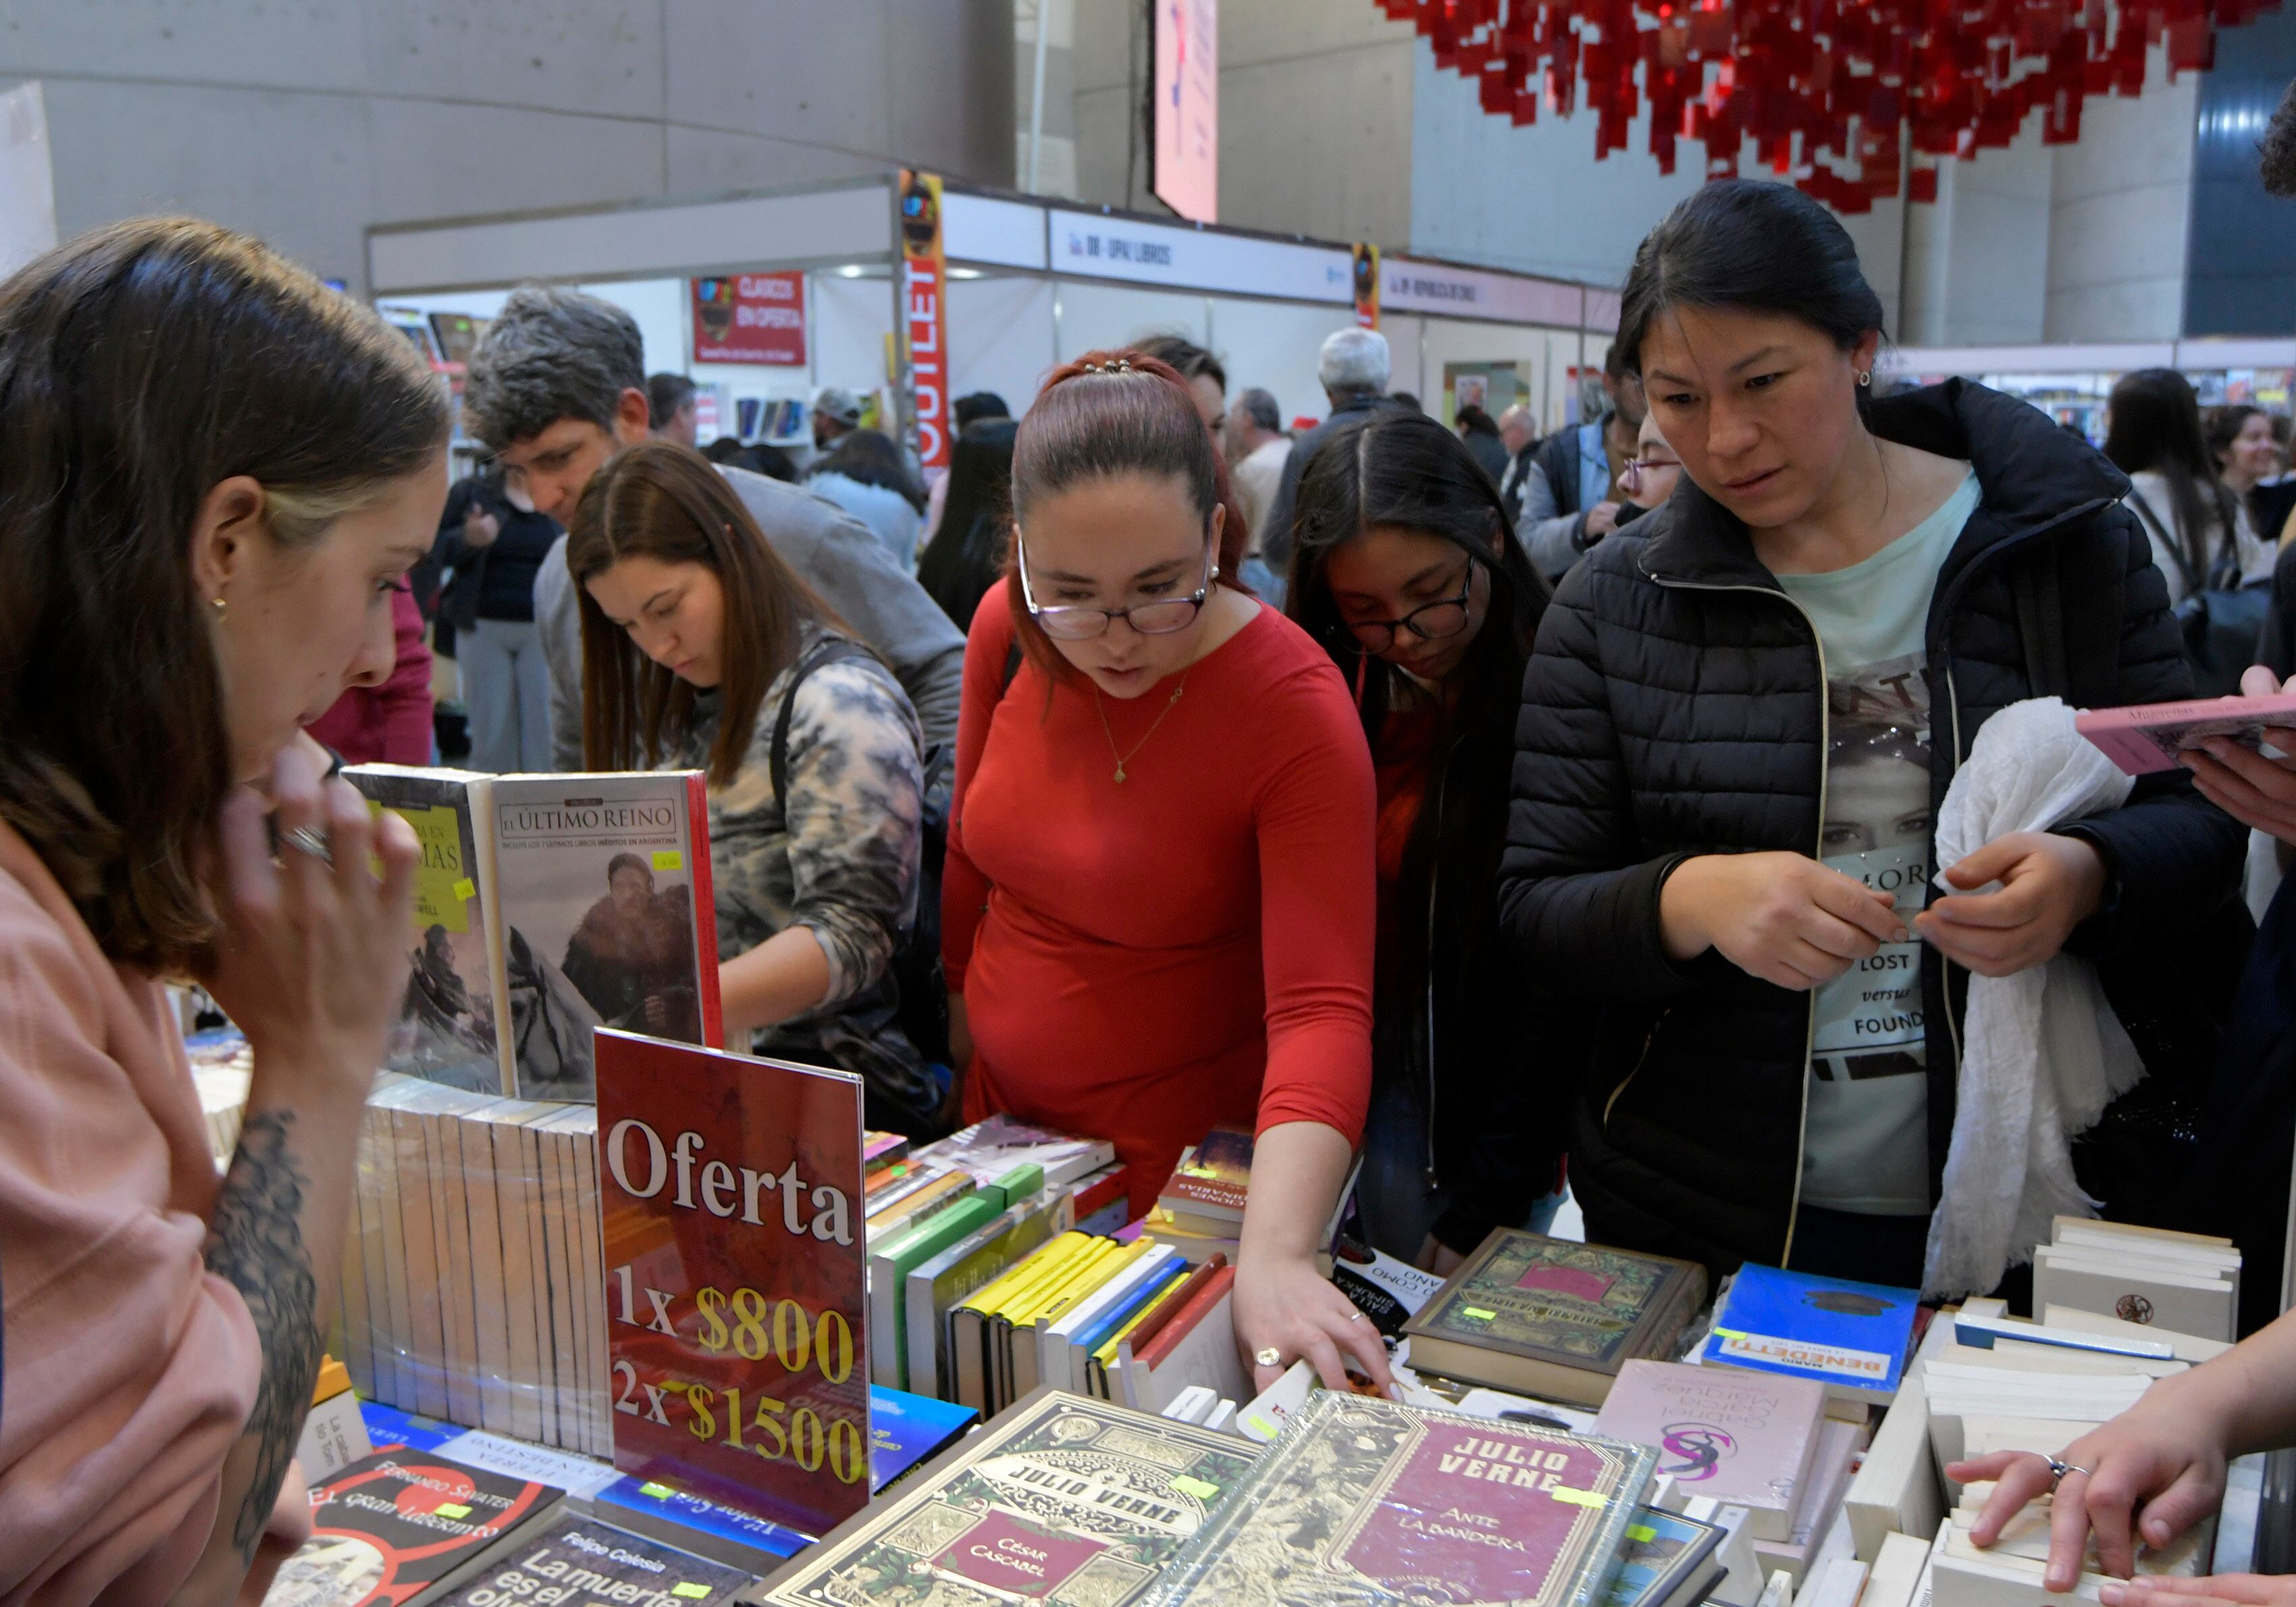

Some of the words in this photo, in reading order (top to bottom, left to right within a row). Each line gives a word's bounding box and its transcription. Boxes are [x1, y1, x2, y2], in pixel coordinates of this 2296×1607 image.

[1136, 243, 1171, 265] LIBROS
[906, 261, 942, 463] OUTLET
[503, 820, 515, 831] EL
[519, 808, 599, 830] ÚLTIMO
[604, 807, 672, 828] REINO
[638, 837, 678, 846] ARGENTINA
[1860, 954, 1910, 972] LOST
[1862, 986, 1911, 1002] versus
[1854, 1013, 1924, 1035] FOUND
[608, 1118, 854, 1247] Oferta
[1178, 1183, 1248, 1201] DINARIAS
[1191, 1191, 1245, 1207] CIONES
[1372, 1267, 1417, 1292] COMO
[1404, 1270, 1440, 1287] ANO
[614, 1263, 678, 1337] 1x
[696, 1285, 854, 1385] $800
[1730, 1339, 1881, 1373] BENEDETTI
[1781, 1356, 1823, 1369] MARIO
[614, 1358, 672, 1427] 2x
[689, 1382, 864, 1485] $1500
[1661, 1406, 1766, 1429] Gabriel
[322, 1439, 335, 1467] Tom
[330, 1415, 340, 1432] La
[335, 1433, 351, 1466] caba
[1453, 1436, 1569, 1471] JULIO
[375, 1460, 450, 1492] FERNANDO
[448, 1483, 515, 1510] SAVATER
[1437, 1453, 1563, 1493] VERNE
[1009, 1464, 1083, 1499] JULIO
[1093, 1487, 1182, 1525] VERNE
[1398, 1516, 1425, 1532] LA
[1428, 1523, 1526, 1552] BANDERA
[1439, 1506, 1502, 1529] ANTE
[561, 1531, 609, 1556] Felipe
[609, 1548, 667, 1573] Celesia
[970, 1543, 1047, 1578] CASCABEL
[495, 1571, 541, 1595] es
[534, 1586, 579, 1607] el
[521, 1548, 570, 1579] La
[562, 1566, 682, 1607] muerte
